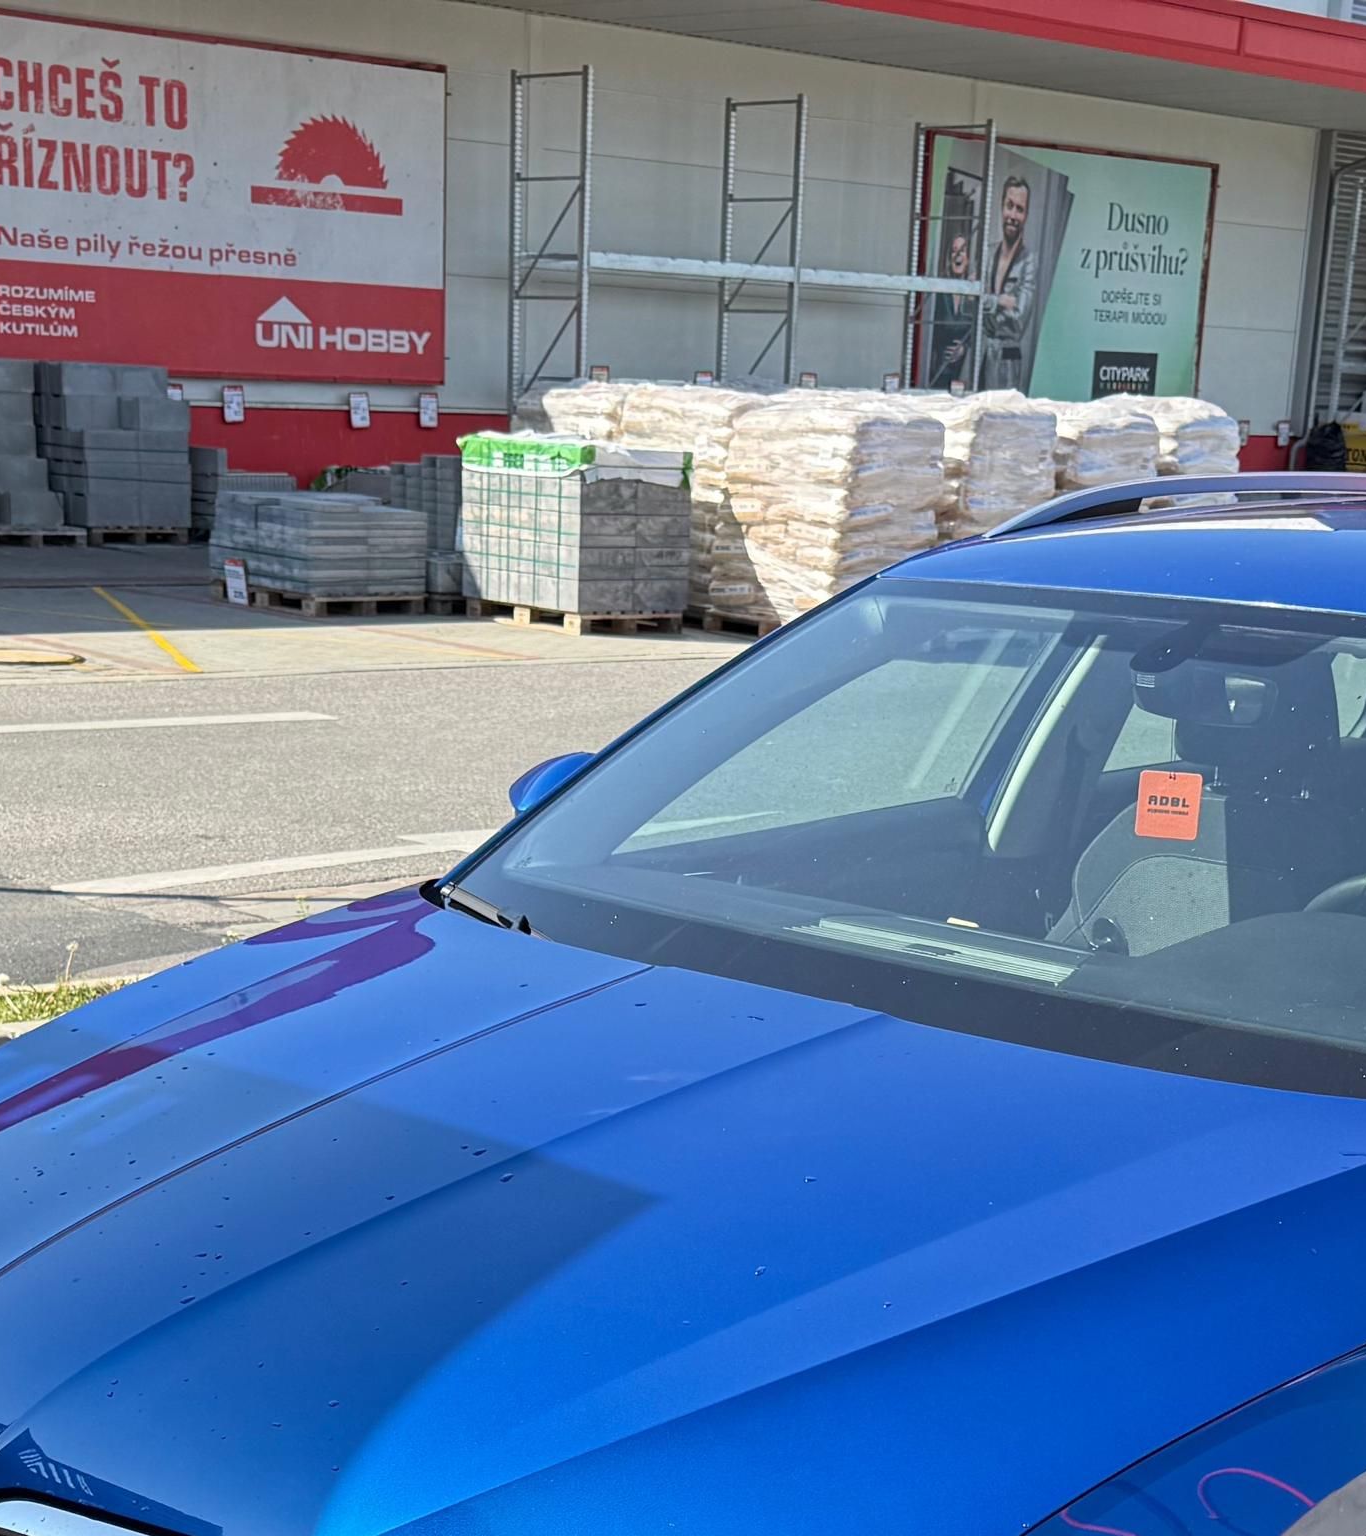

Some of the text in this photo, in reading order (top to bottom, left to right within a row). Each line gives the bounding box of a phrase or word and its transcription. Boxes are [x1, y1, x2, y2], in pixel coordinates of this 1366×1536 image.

[138, 75, 188, 130] TO
[1107, 202, 1169, 236] Dusno
[76, 233, 121, 259] pily
[128, 236, 203, 261] řežou
[208, 243, 298, 267] přesně
[1079, 241, 1189, 278] z průšvihu?
[1101, 288, 1162, 306] DOPŘEJTE SI
[0, 320, 79, 338] KUTILŮM
[1093, 309, 1129, 324] TERAPII
[255, 322, 431, 355] UNI HOBBY
[1099, 365, 1151, 382] CITYPARK
[1148, 795, 1190, 808] ADBL
